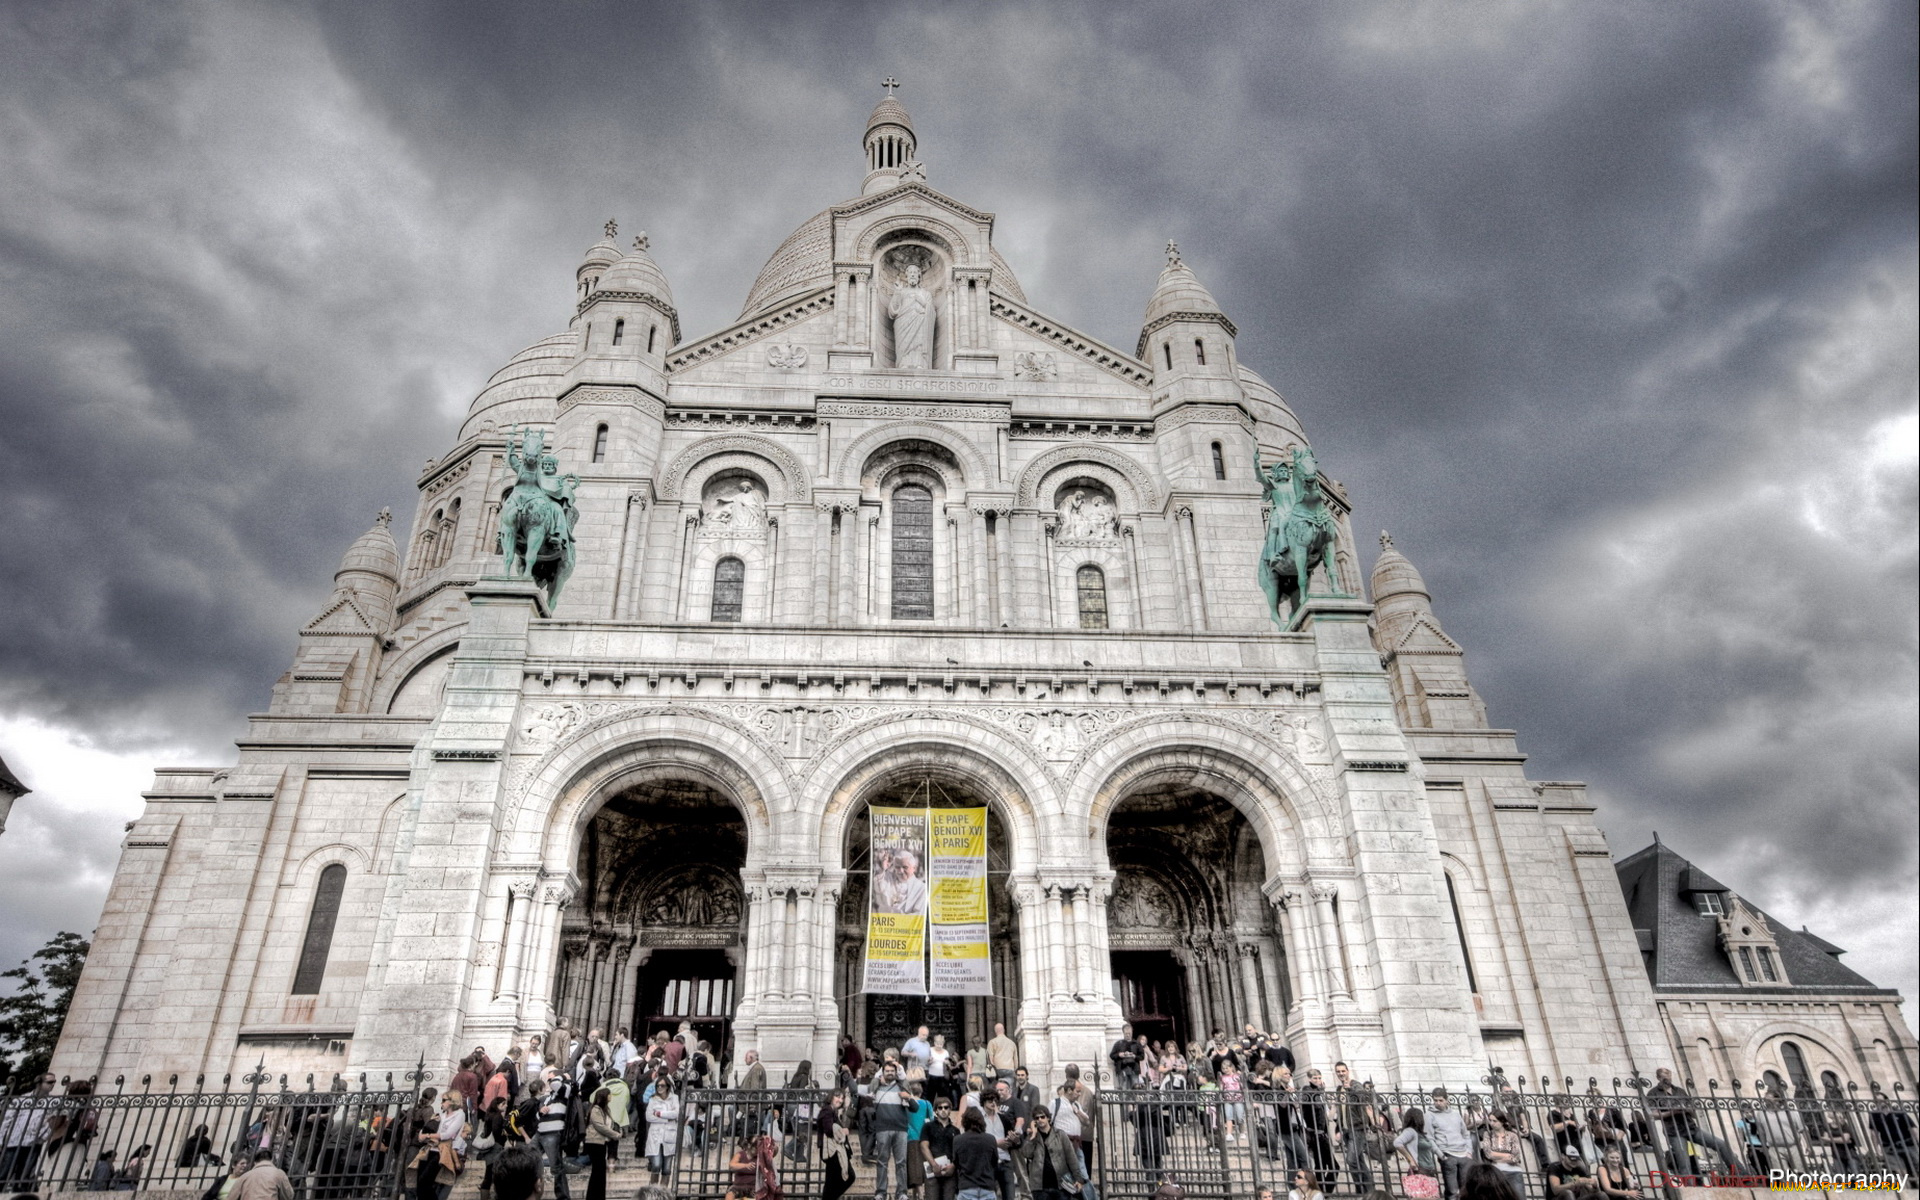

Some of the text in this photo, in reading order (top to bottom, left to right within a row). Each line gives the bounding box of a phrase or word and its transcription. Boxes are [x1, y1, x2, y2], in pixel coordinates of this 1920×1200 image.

[830, 377, 854, 388] COR
[860, 378, 892, 389] JESU
[873, 814, 924, 826] BIENVENUE
[946, 814, 969, 824] PAPE
[888, 826, 912, 837] PAPE
[908, 839, 923, 851] XVI
[942, 837, 970, 849] PARIS
[872, 916, 896, 927] PARIS
[884, 927, 911, 935] SEPTEMBRE
[869, 939, 907, 950] LOURDES
